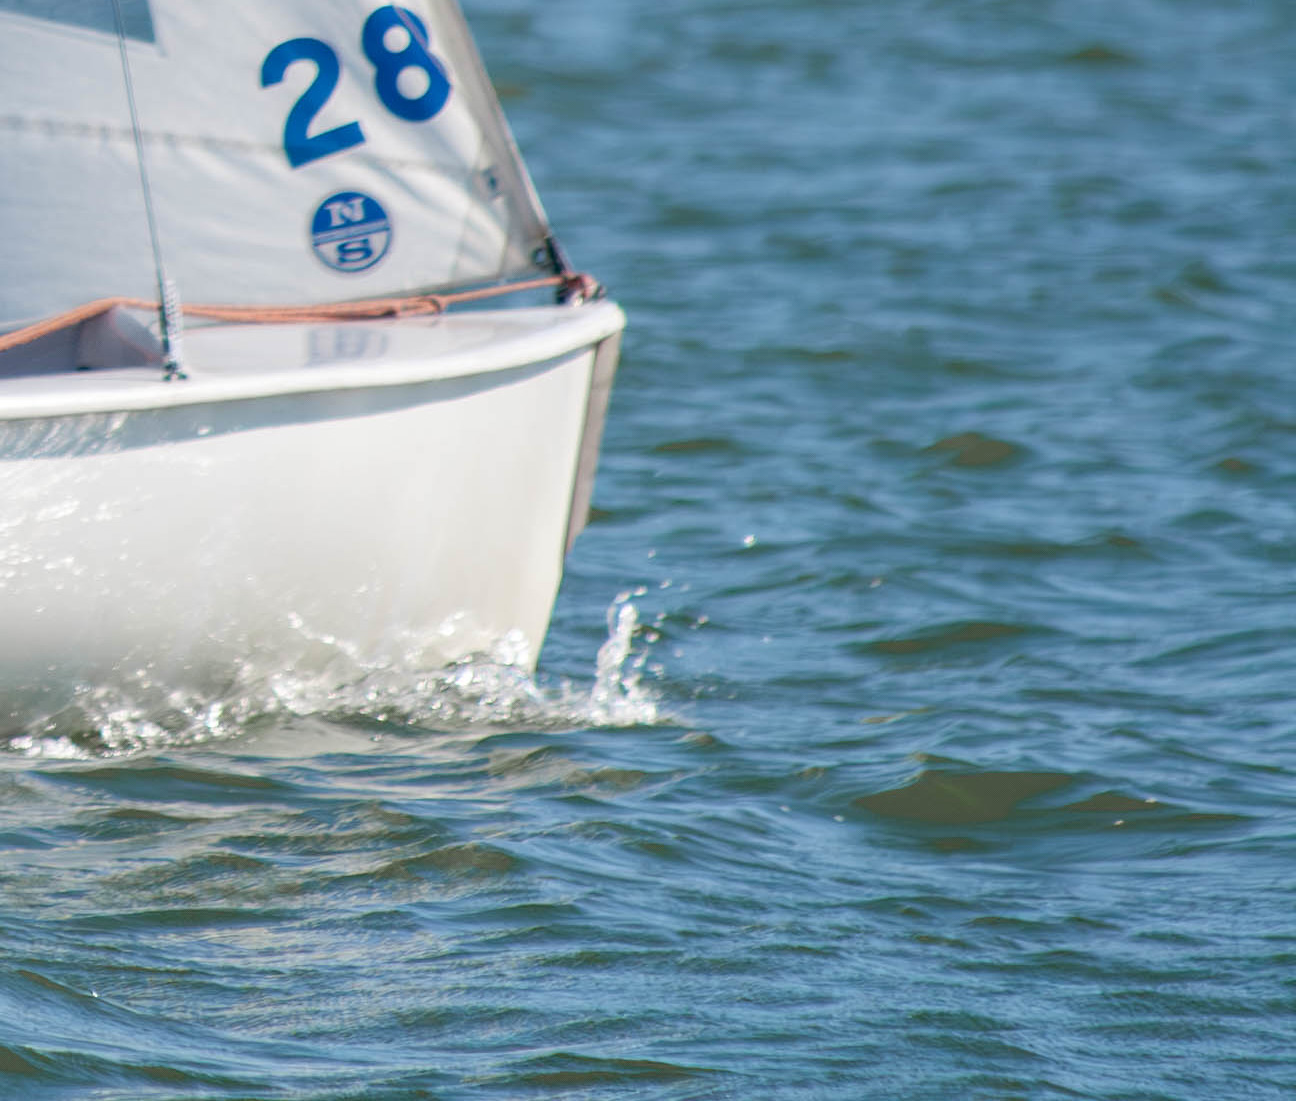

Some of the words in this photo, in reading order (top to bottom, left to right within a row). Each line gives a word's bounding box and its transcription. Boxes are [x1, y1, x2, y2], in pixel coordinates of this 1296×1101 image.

[261, 4, 451, 168] 28
[324, 197, 365, 226] N
[337, 238, 373, 263] S
